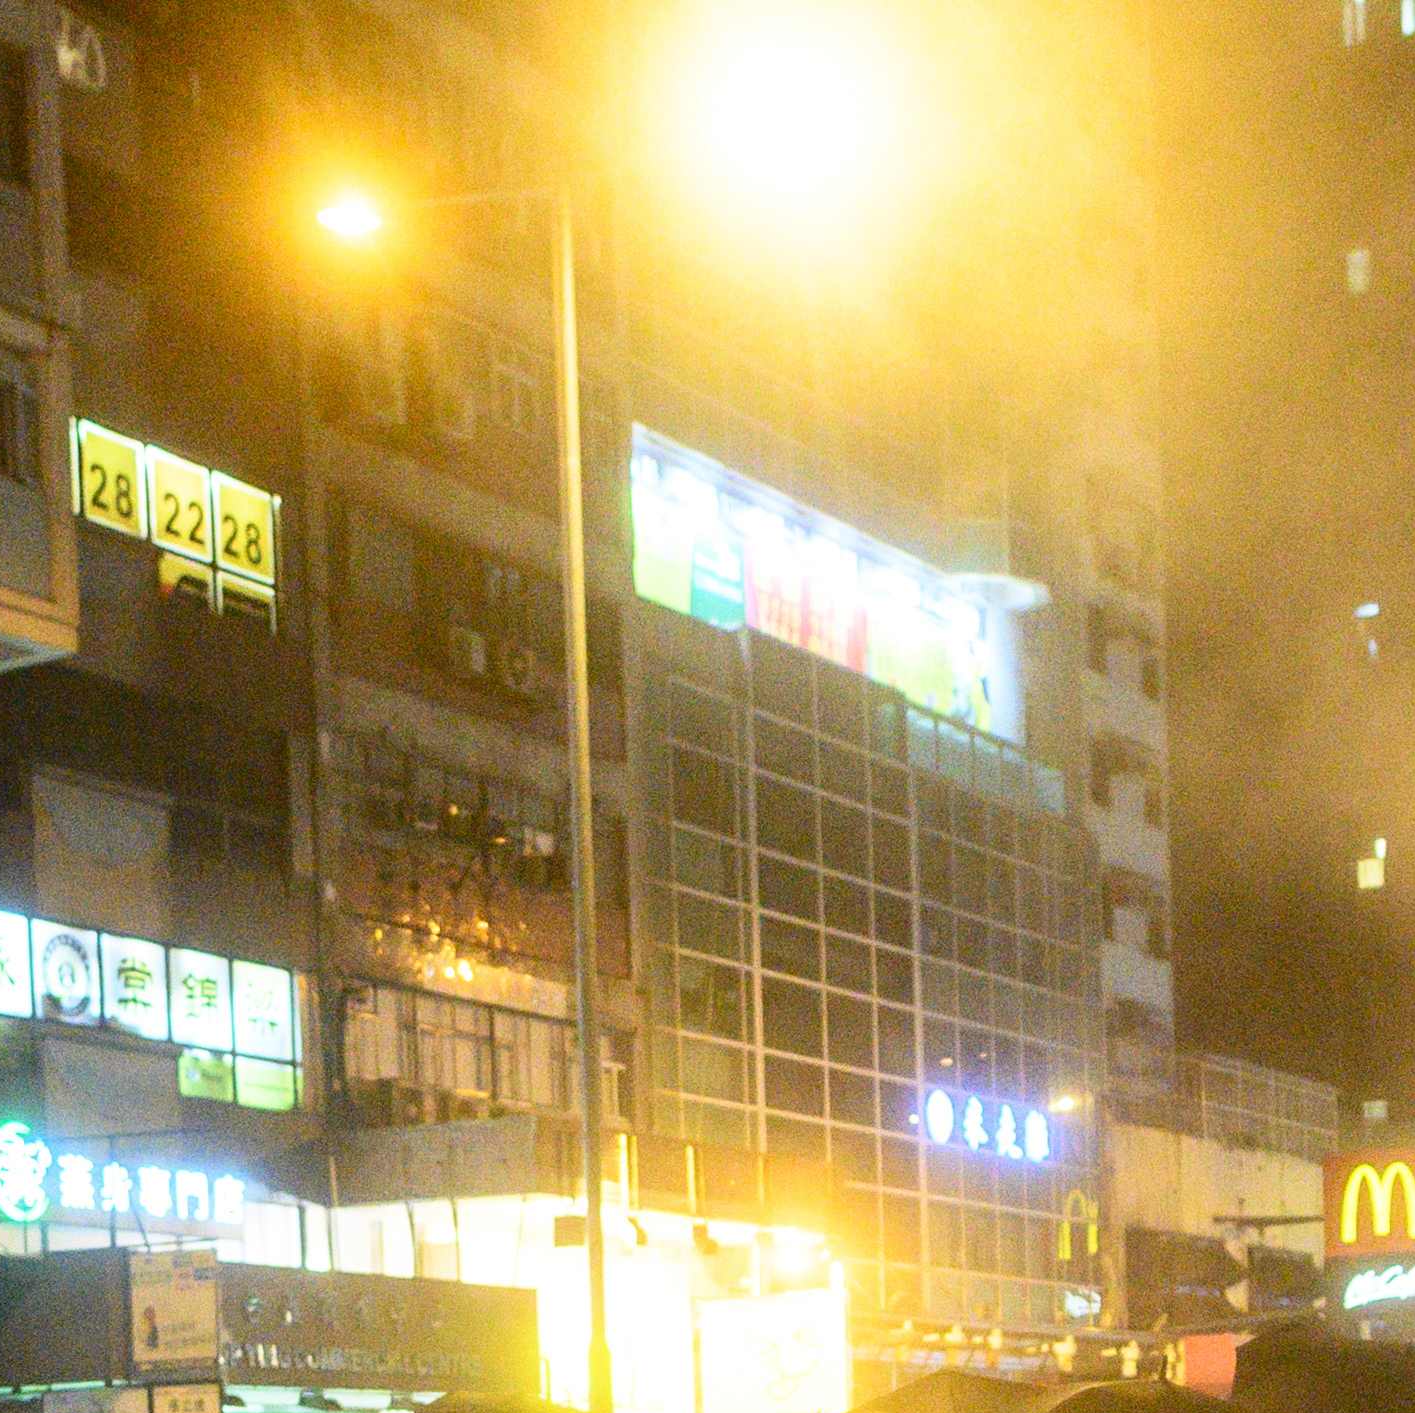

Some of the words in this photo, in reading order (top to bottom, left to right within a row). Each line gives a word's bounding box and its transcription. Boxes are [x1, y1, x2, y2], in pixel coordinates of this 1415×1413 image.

[89, 463, 133, 519] 28
[163, 492, 206, 547] 22
[221, 514, 263, 566] 28
